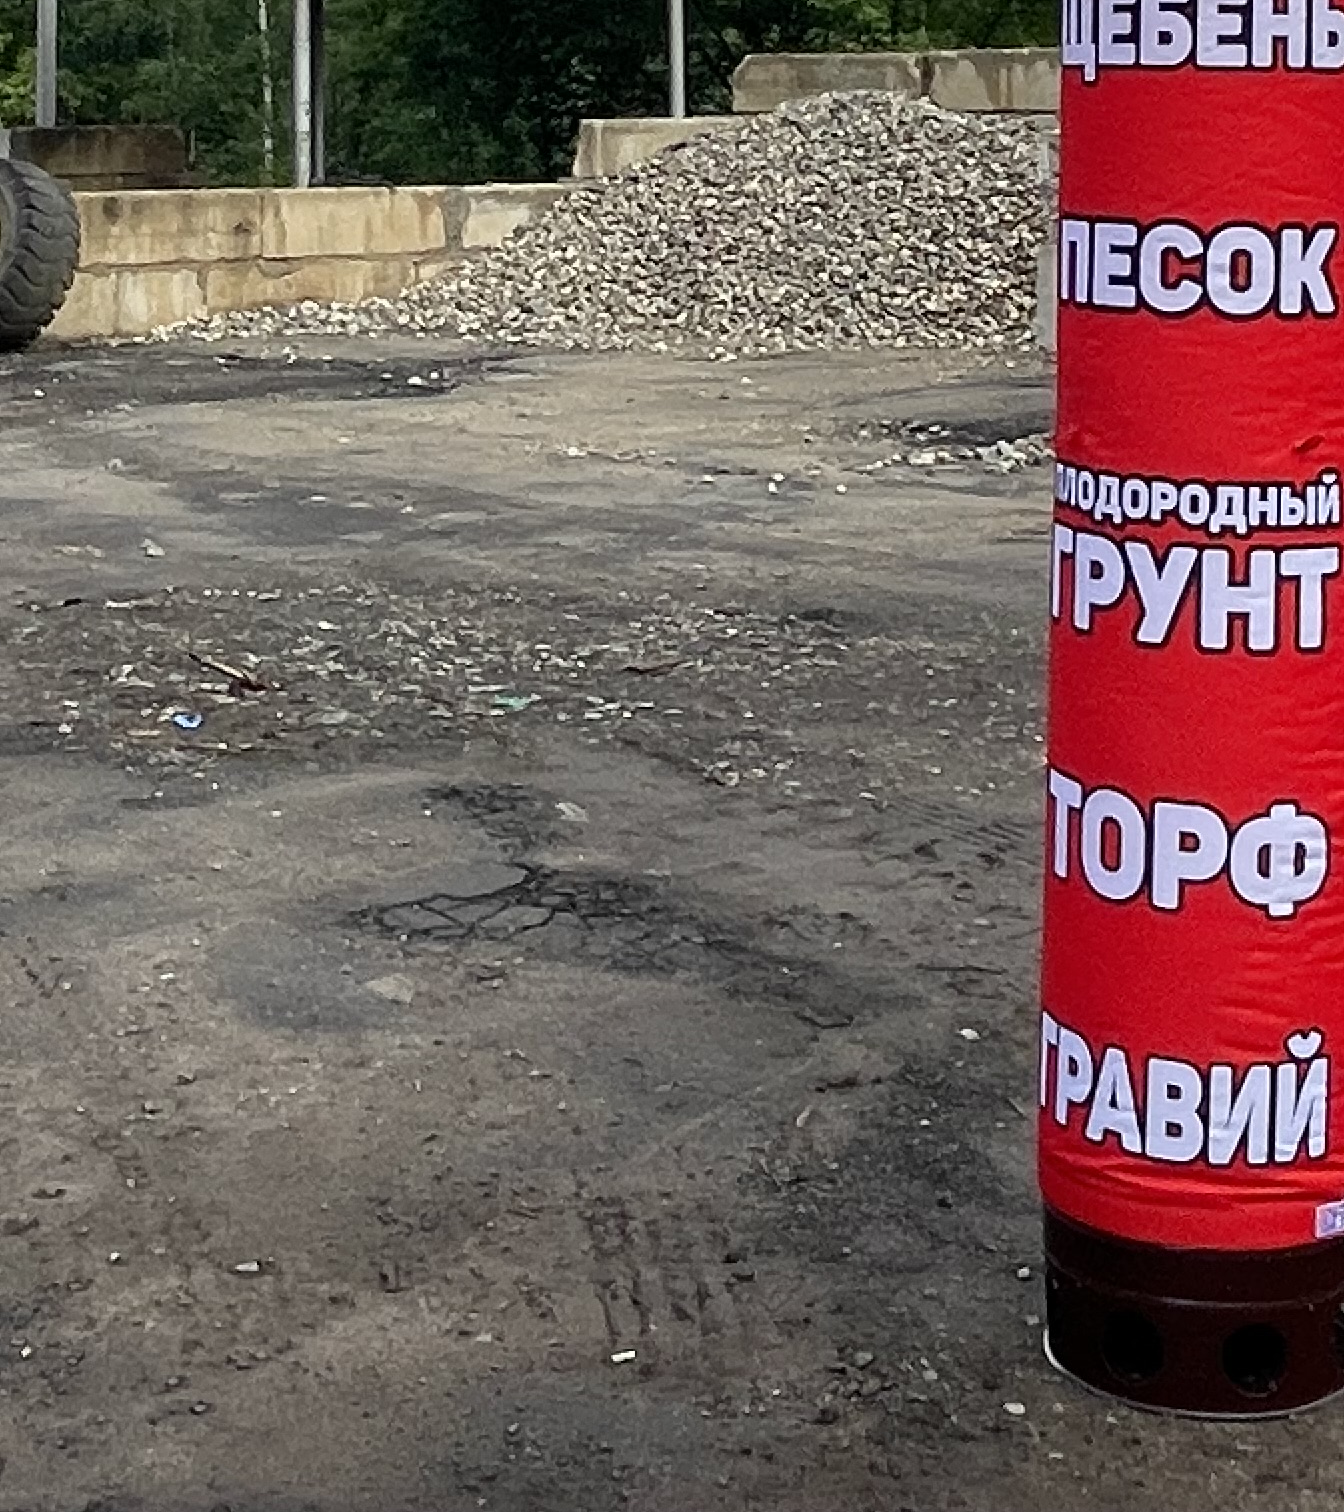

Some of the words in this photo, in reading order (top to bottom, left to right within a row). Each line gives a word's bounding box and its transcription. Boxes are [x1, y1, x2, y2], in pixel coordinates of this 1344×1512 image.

[1060, 216, 1338, 317] ПЕСОК
[1056, 462, 1341, 535] ЛОДОРОДНЫЙ
[1052, 521, 1341, 653] ГРУНТ
[1049, 767, 1329, 917] ТОРФ
[1041, 1010, 1329, 1166] ГРАВИЙ
